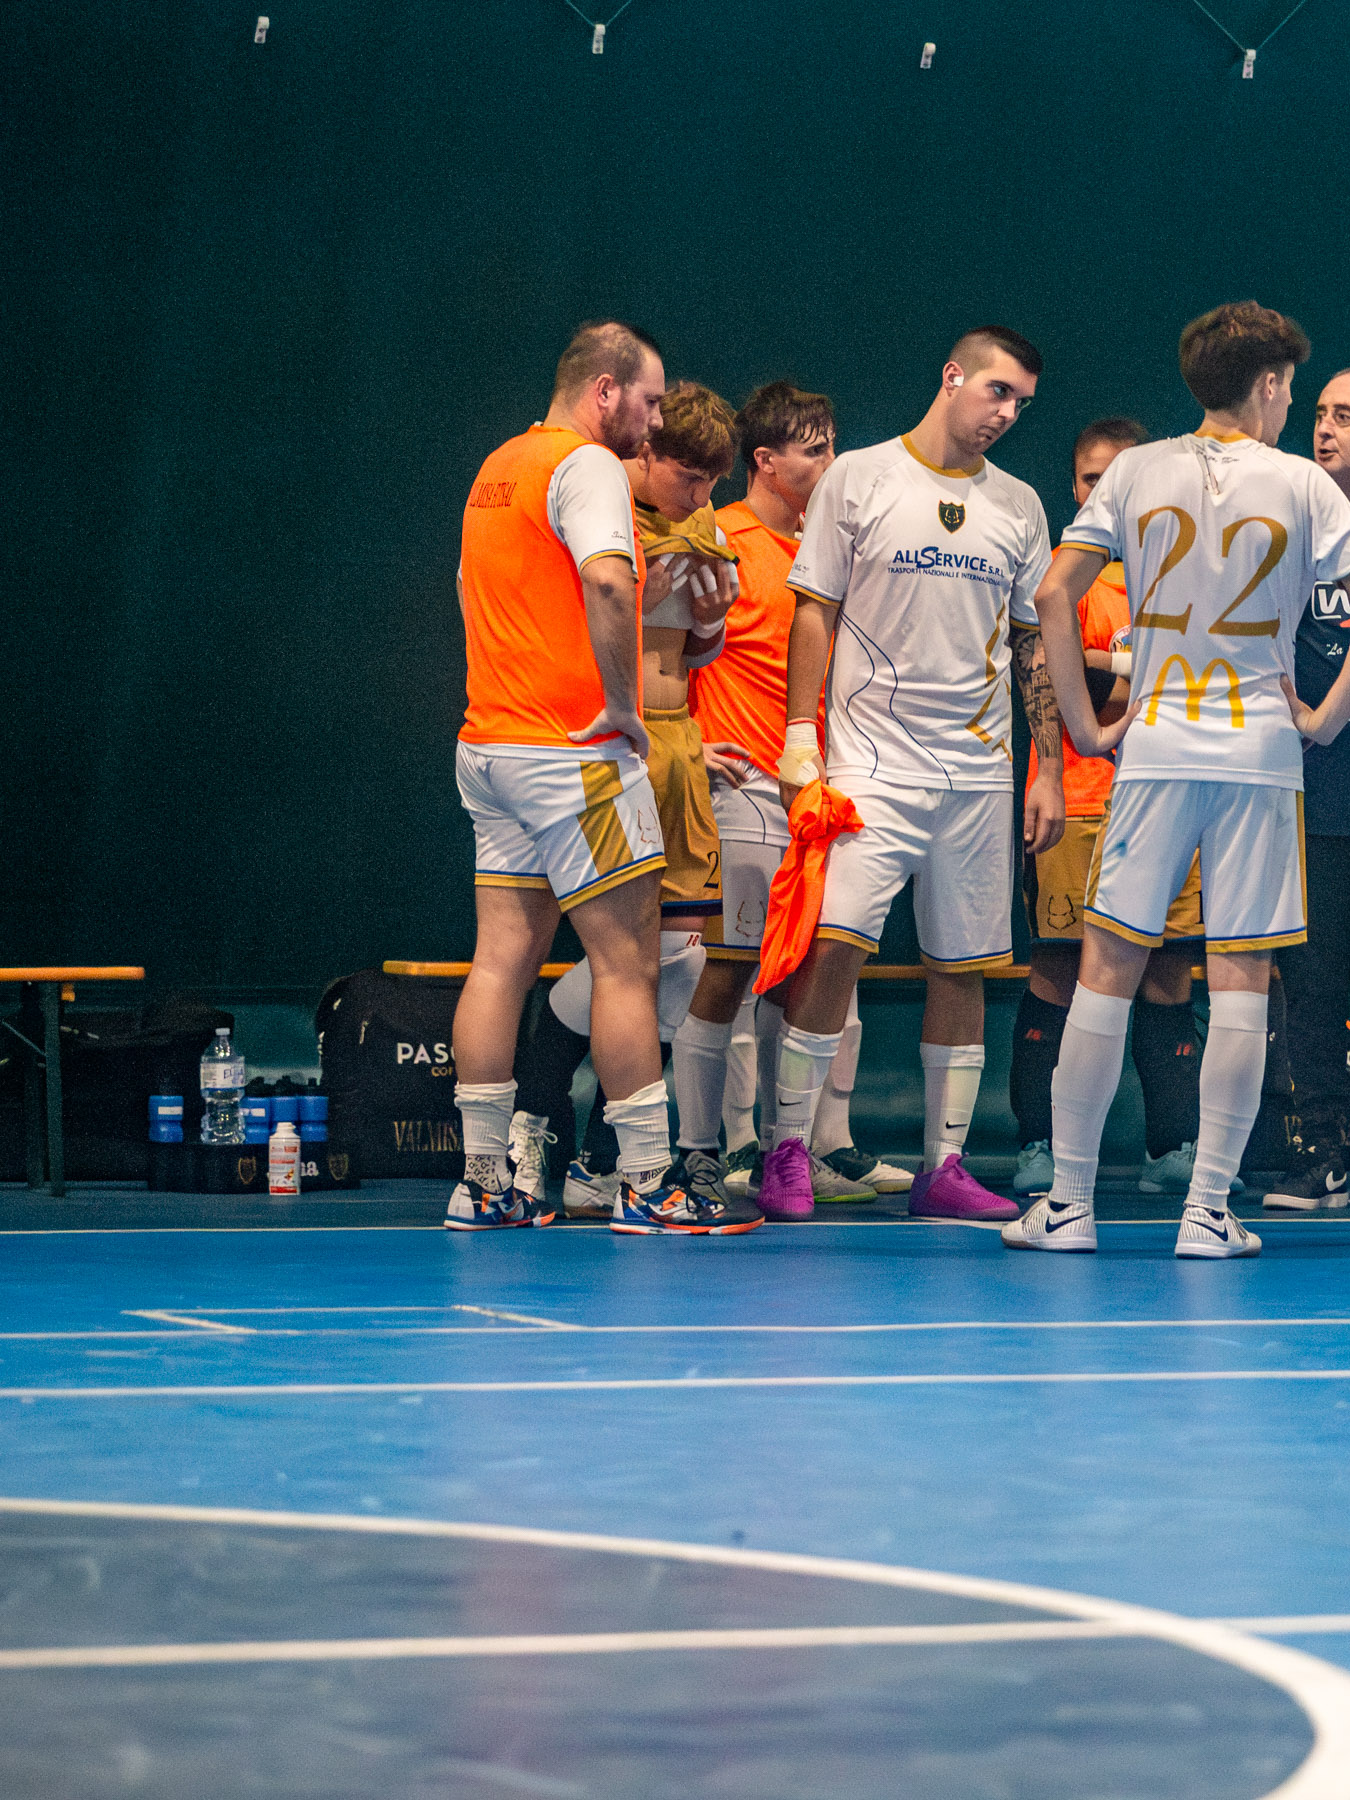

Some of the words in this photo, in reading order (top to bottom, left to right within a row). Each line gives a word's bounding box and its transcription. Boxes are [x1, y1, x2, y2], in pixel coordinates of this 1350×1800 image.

[887, 567, 921, 575] TRASPORTI
[922, 568, 955, 578] NAZIONALI
[892, 546, 988, 573] ALLSERVICE
[1134, 505, 1288, 638] 22
[703, 850, 720, 890] 2
